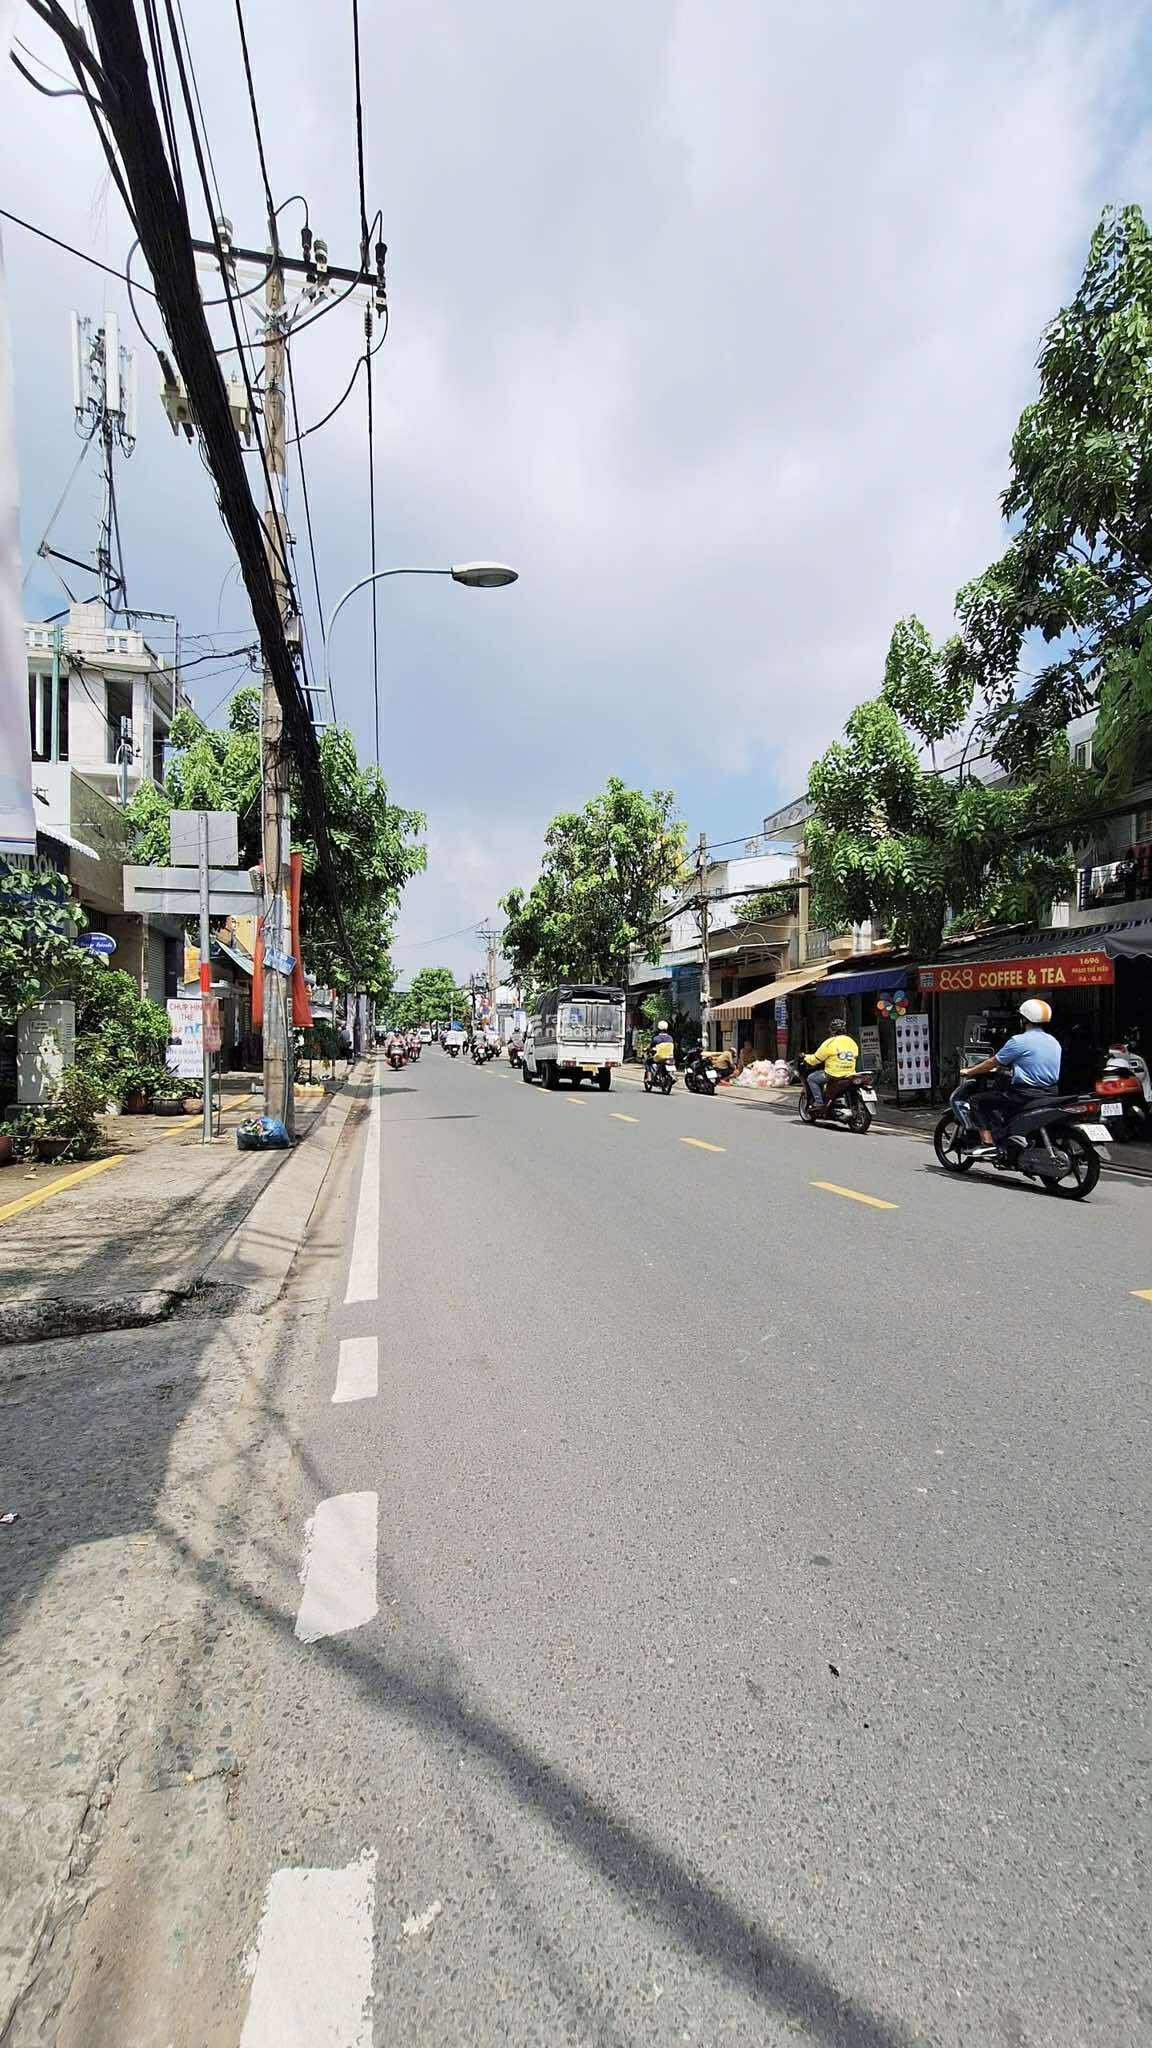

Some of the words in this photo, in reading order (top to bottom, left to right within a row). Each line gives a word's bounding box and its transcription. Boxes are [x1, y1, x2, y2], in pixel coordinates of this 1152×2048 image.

[1079, 957, 1100, 965] 1696
[940, 969, 973, 991] 868
[978, 970, 1023, 988] COFFEE
[1027, 969, 1037, 984] &
[1040, 967, 1066, 984] TEA
